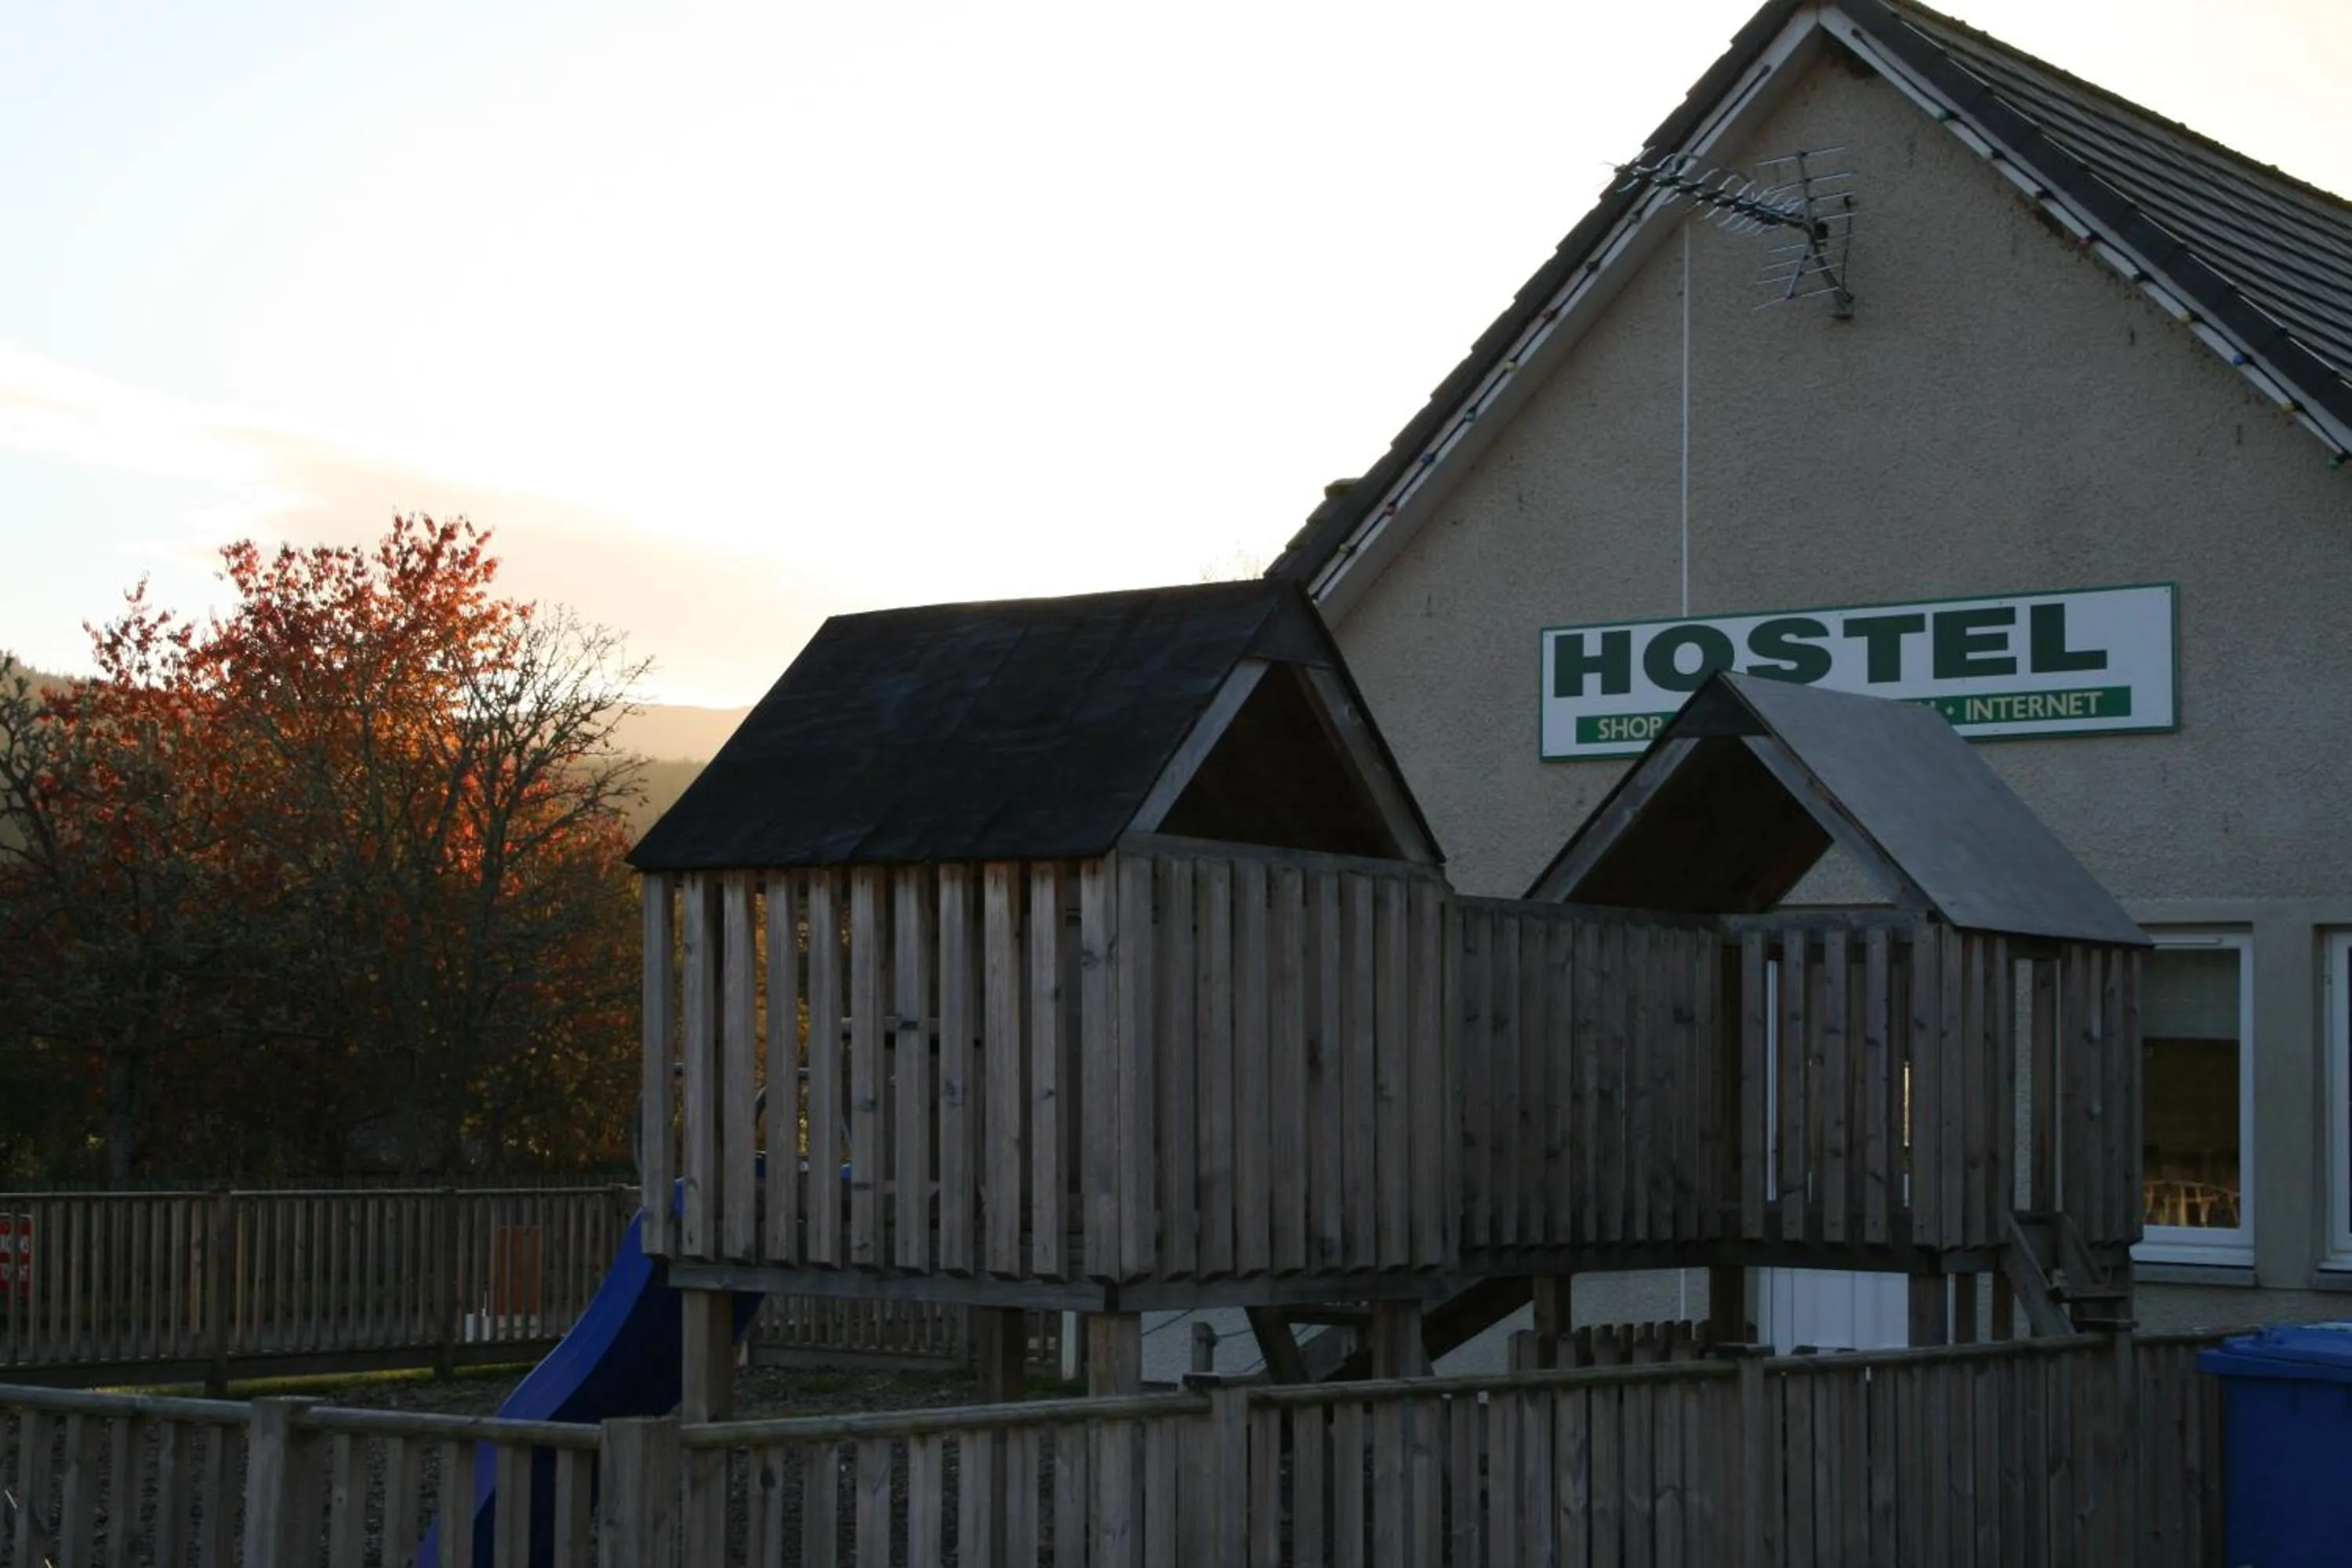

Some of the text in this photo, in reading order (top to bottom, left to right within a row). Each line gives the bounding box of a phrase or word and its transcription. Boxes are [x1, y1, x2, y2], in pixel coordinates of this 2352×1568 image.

[1554, 603, 2108, 698] HOSTEL
[1597, 691, 2103, 740] SHOP INTERNET
